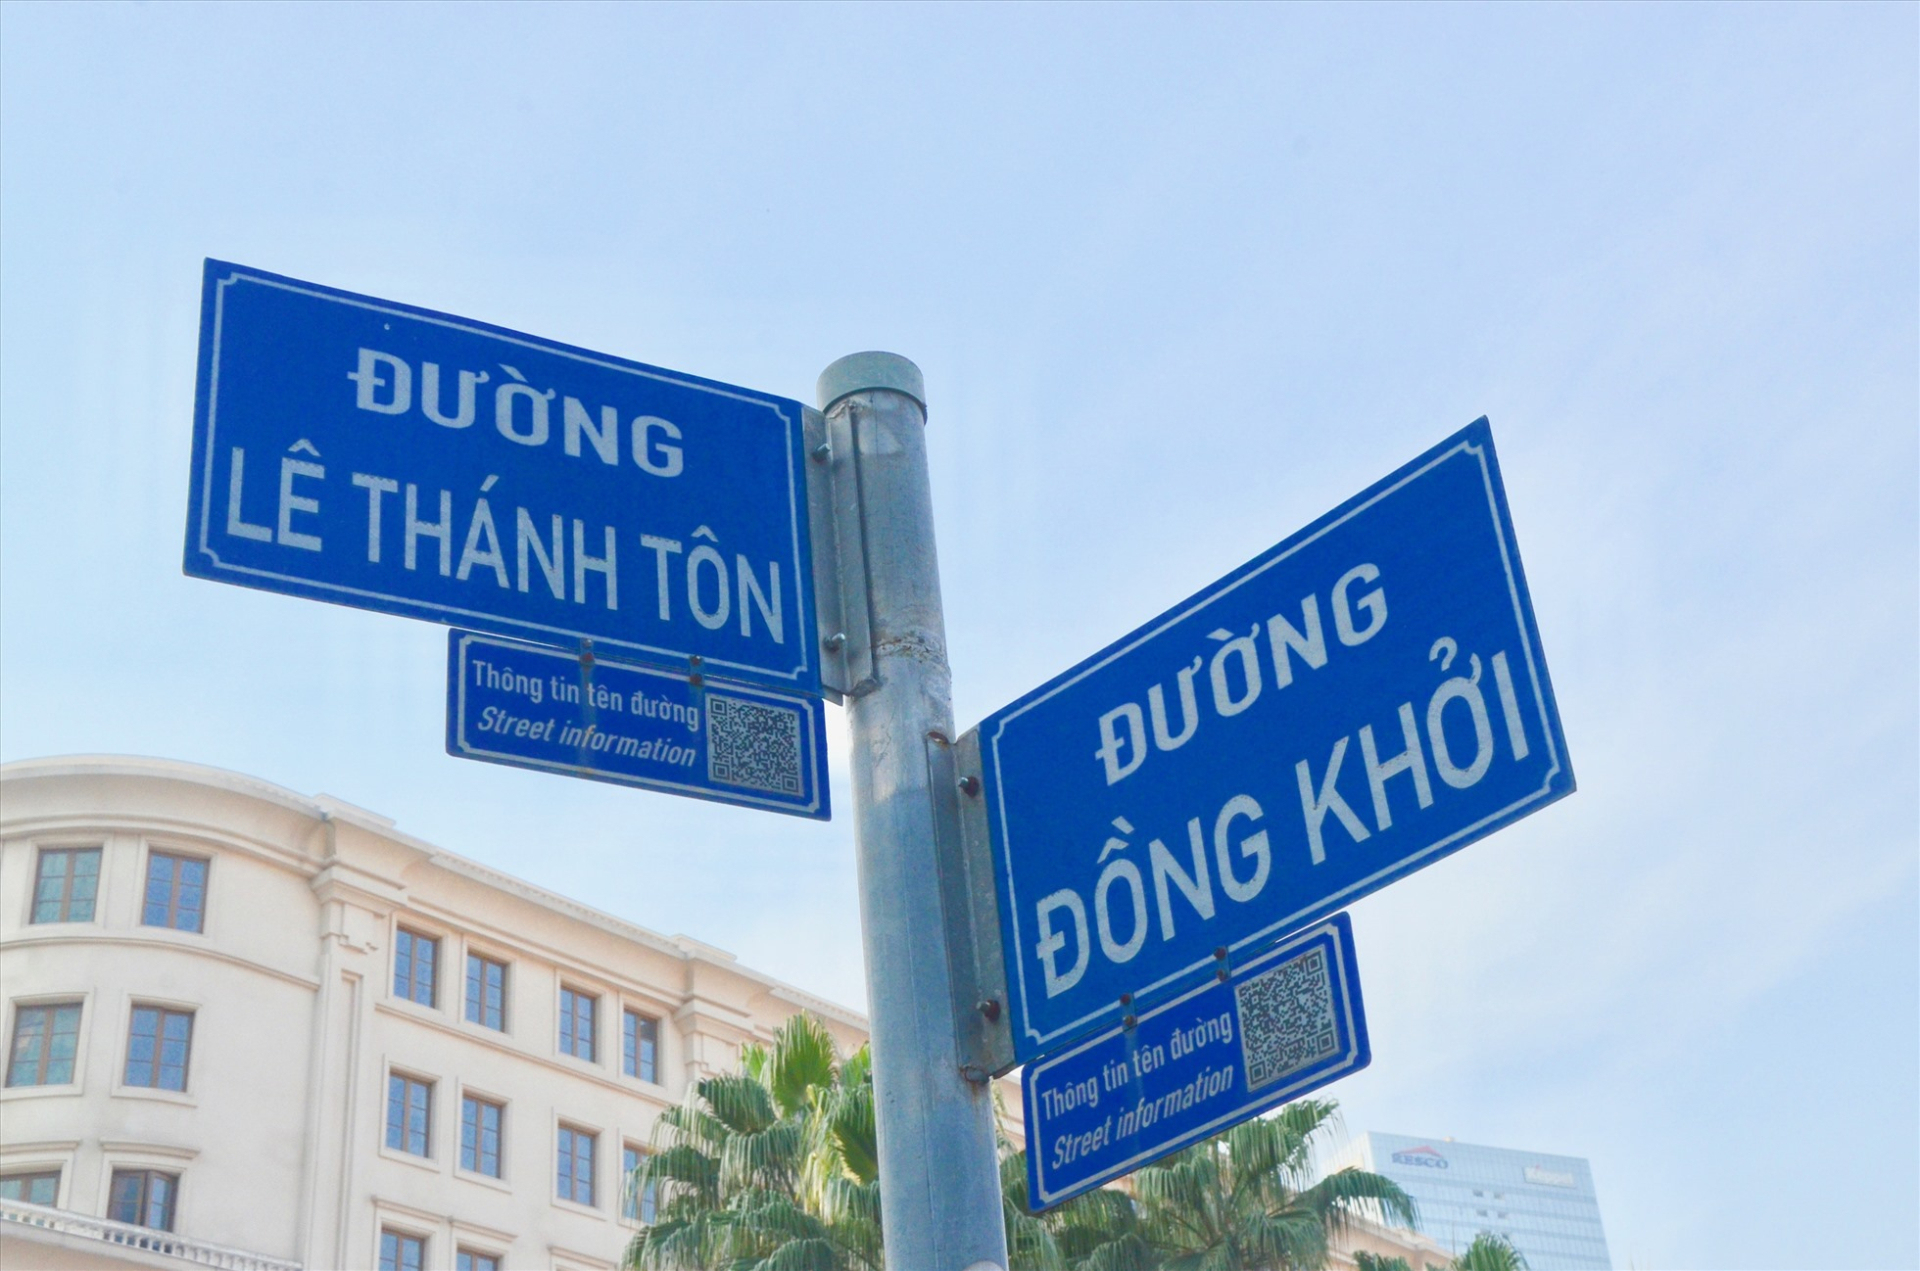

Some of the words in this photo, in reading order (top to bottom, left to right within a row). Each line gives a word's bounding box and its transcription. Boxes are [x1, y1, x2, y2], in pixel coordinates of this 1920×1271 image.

[347, 348, 684, 477] ĐƯỜNG
[227, 439, 325, 552] LÊ
[353, 475, 618, 611] THÁNH
[641, 525, 784, 644] TÔN
[473, 660, 543, 702] Thông
[550, 676, 580, 702] tin
[586, 683, 624, 712] tên
[631, 690, 700, 732] đường
[1095, 563, 1388, 786] ĐƯỜNG
[477, 706, 555, 742] Street
[558, 720, 697, 767] information
[1036, 794, 1272, 999] ĐỒNG
[1295, 636, 1529, 866] KHỞI
[1042, 1076, 1099, 1120] Thông
[1103, 1064, 1128, 1092] tin
[1133, 1045, 1164, 1078] tên
[1170, 1012, 1233, 1059] đường
[1052, 1118, 1112, 1170] Street
[1116, 1065, 1233, 1141] information
